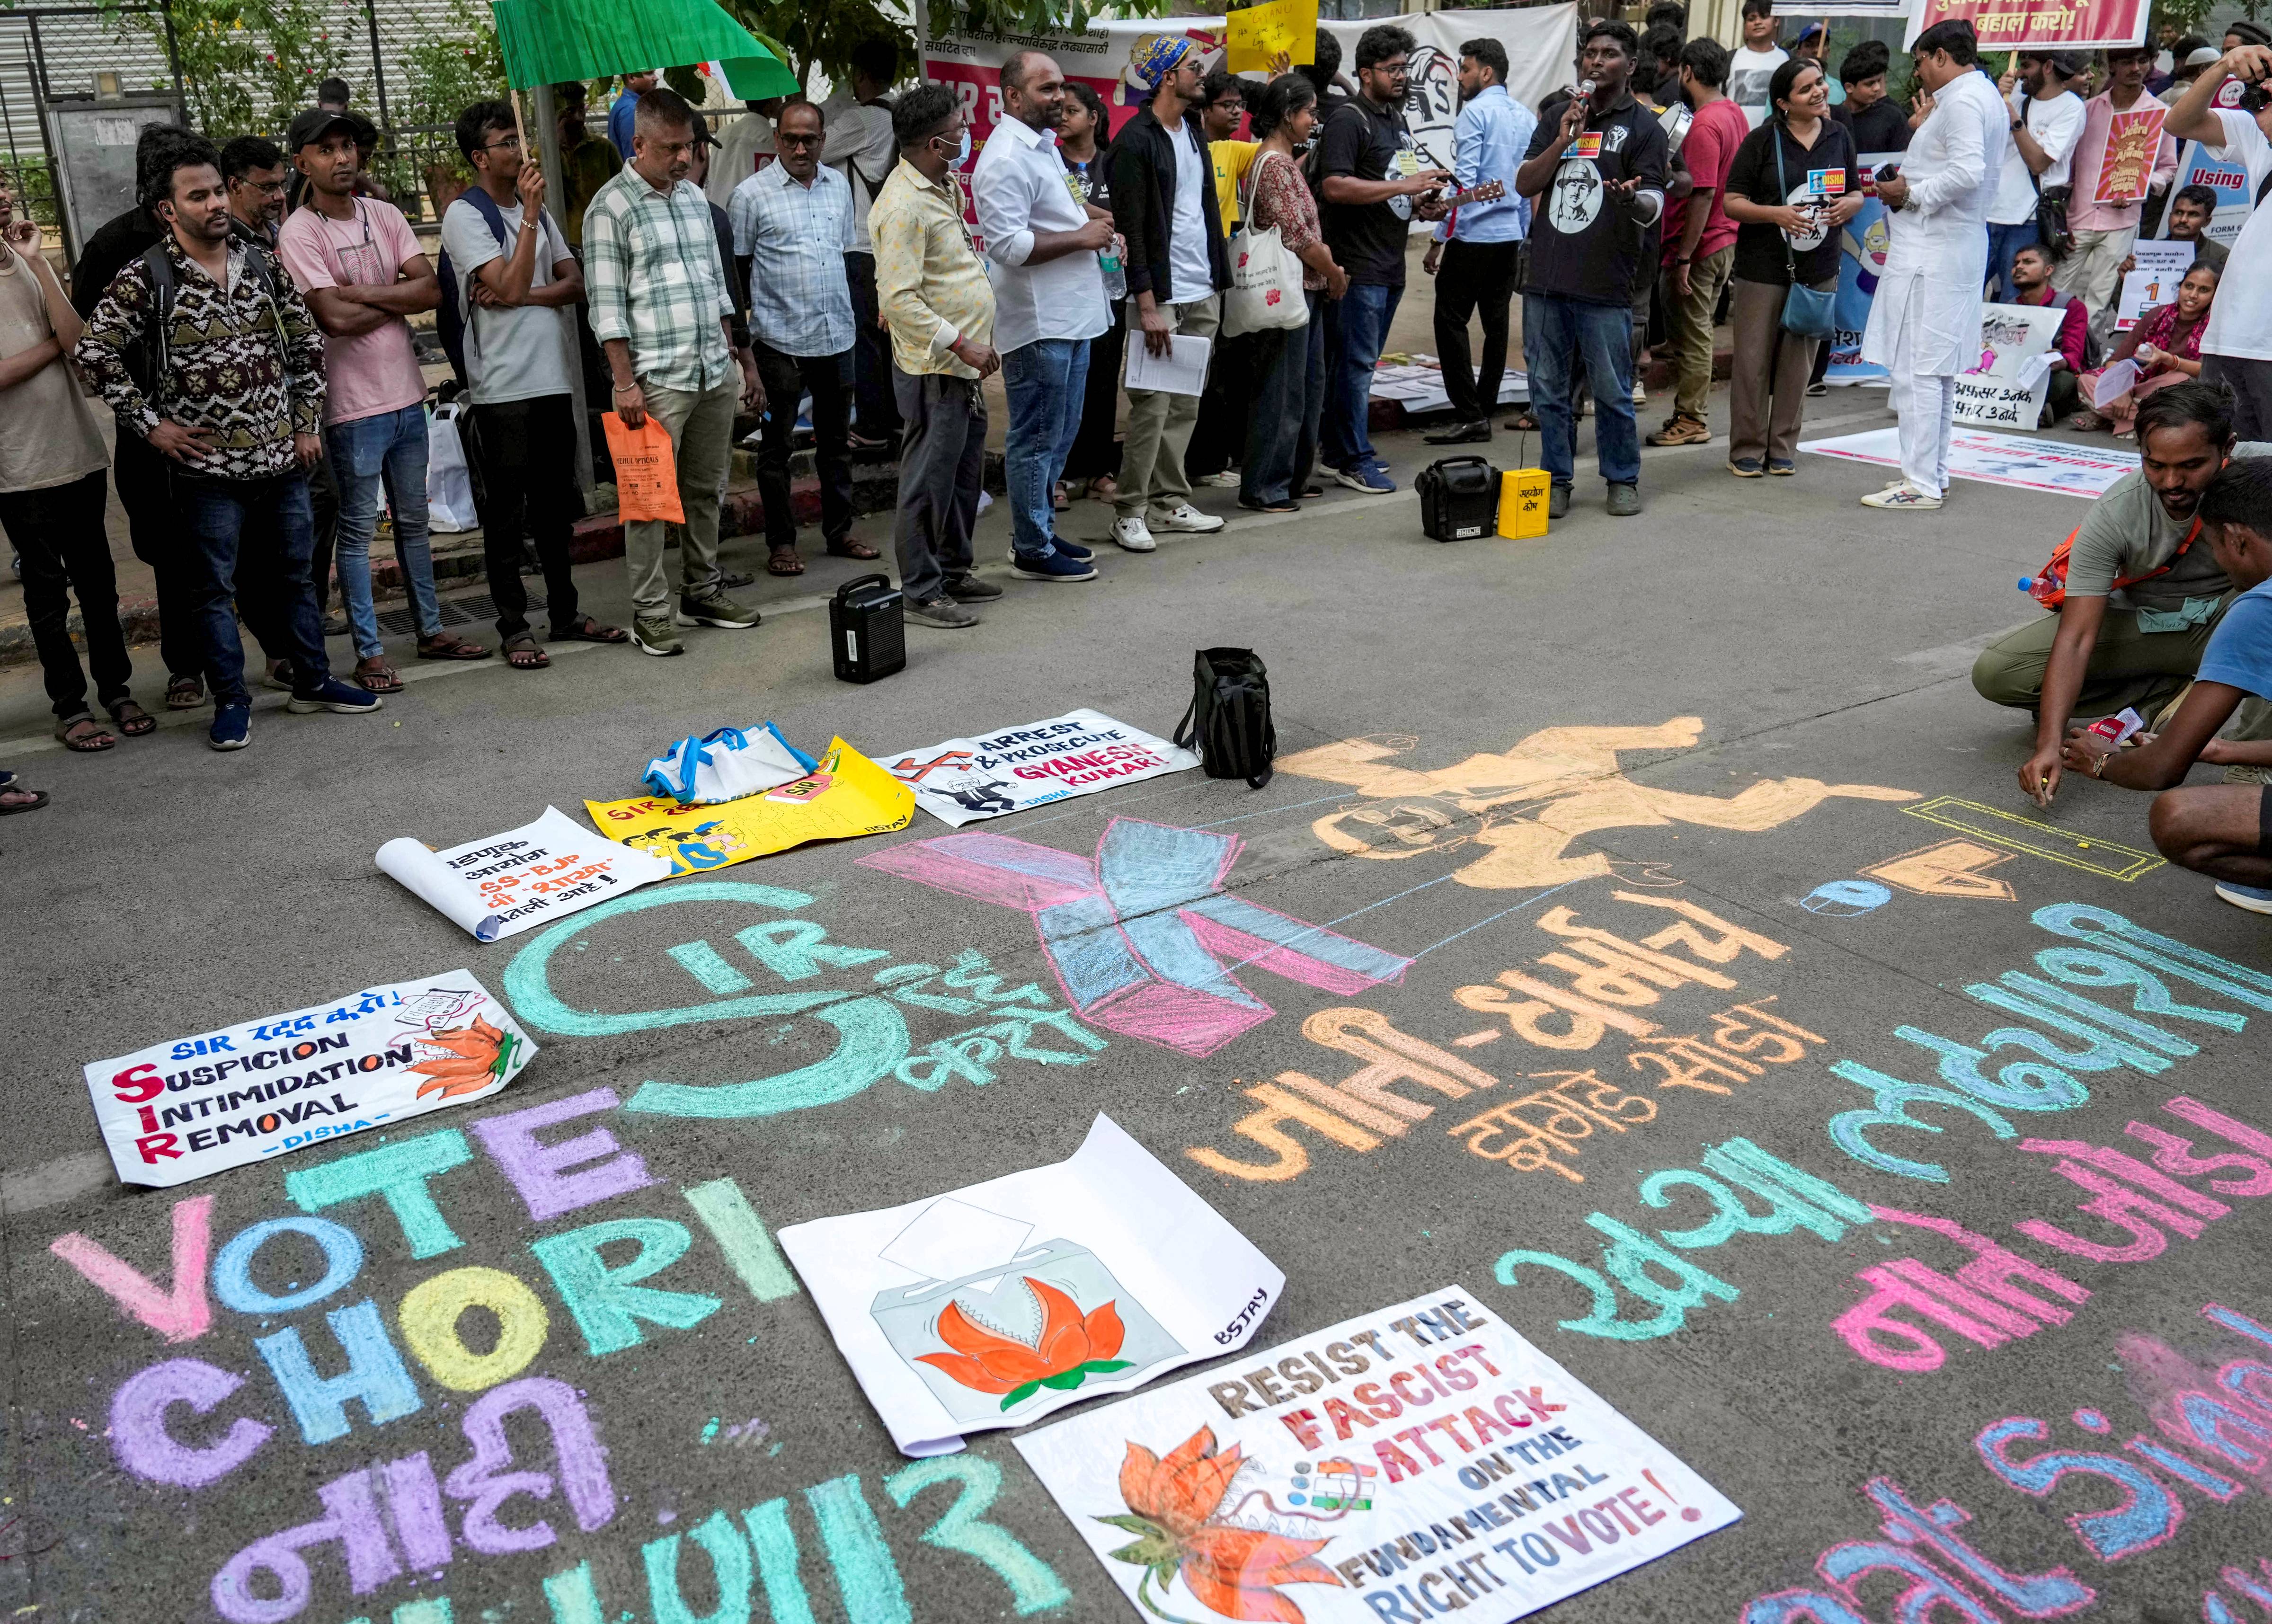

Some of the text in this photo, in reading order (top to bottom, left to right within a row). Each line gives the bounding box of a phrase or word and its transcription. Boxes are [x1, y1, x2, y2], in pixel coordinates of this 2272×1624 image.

[1976, 12, 2028, 32] बहाल
[2030, 5, 2076, 31] करो!
[1060, 41, 1109, 54] लढ्यासाठी
[1576, 137, 1600, 148] DISHA
[2114, 148, 2144, 163] Ajwain
[1823, 173, 1845, 185] DISHA
[2192, 168, 2245, 190] Using
[2211, 225, 2235, 234] FORM
[1985, 403, 2021, 423] उनके
[1999, 389, 2035, 403] उनक
[635, 456, 658, 464] OPTICALS
[1519, 486, 1545, 497] सहयोग
[1523, 500, 1538, 512] कोष
[1456, 526, 1481, 538] AHUJA
[979, 721, 1085, 752] ARREST
[997, 729, 1127, 764] PROSECUTE
[1012, 743, 1152, 782] GYANESH
[1061, 755, 1171, 788] KUMAR!
[784, 781, 823, 796] SIR
[607, 800, 666, 821] SIR
[465, 848, 550, 880] आयोग
[479, 854, 580, 897] SS-BJP
[504, 879, 913, 1120] SIR
[170, 1035, 238, 1060] SIR
[1628, 993, 1828, 1097] सोडा
[112, 1032, 349, 1104] SUSPICION
[137, 1044, 417, 1134] INTIMIDATION
[134, 1093, 359, 1164] REMOVAL
[1446, 1067, 1659, 1184] झगडे
[2013, 1095, 2272, 1264] जोडा
[50, 1085, 654, 1346] VOTE
[108, 1176, 802, 1490] CHORI
[1206, 1299, 1489, 1420] RESIST THE
[1279, 1344, 1505, 1452] FASCIST
[1371, 1384, 1568, 1485] ATTACK
[1458, 1425, 1584, 1490] ON THE
[212, 1375, 616, 1624] नाही
[1336, 1463, 1610, 1589] FUNDAMENTAL
[1363, 1467, 1703, 1624] RIGHT TO VOTE!
